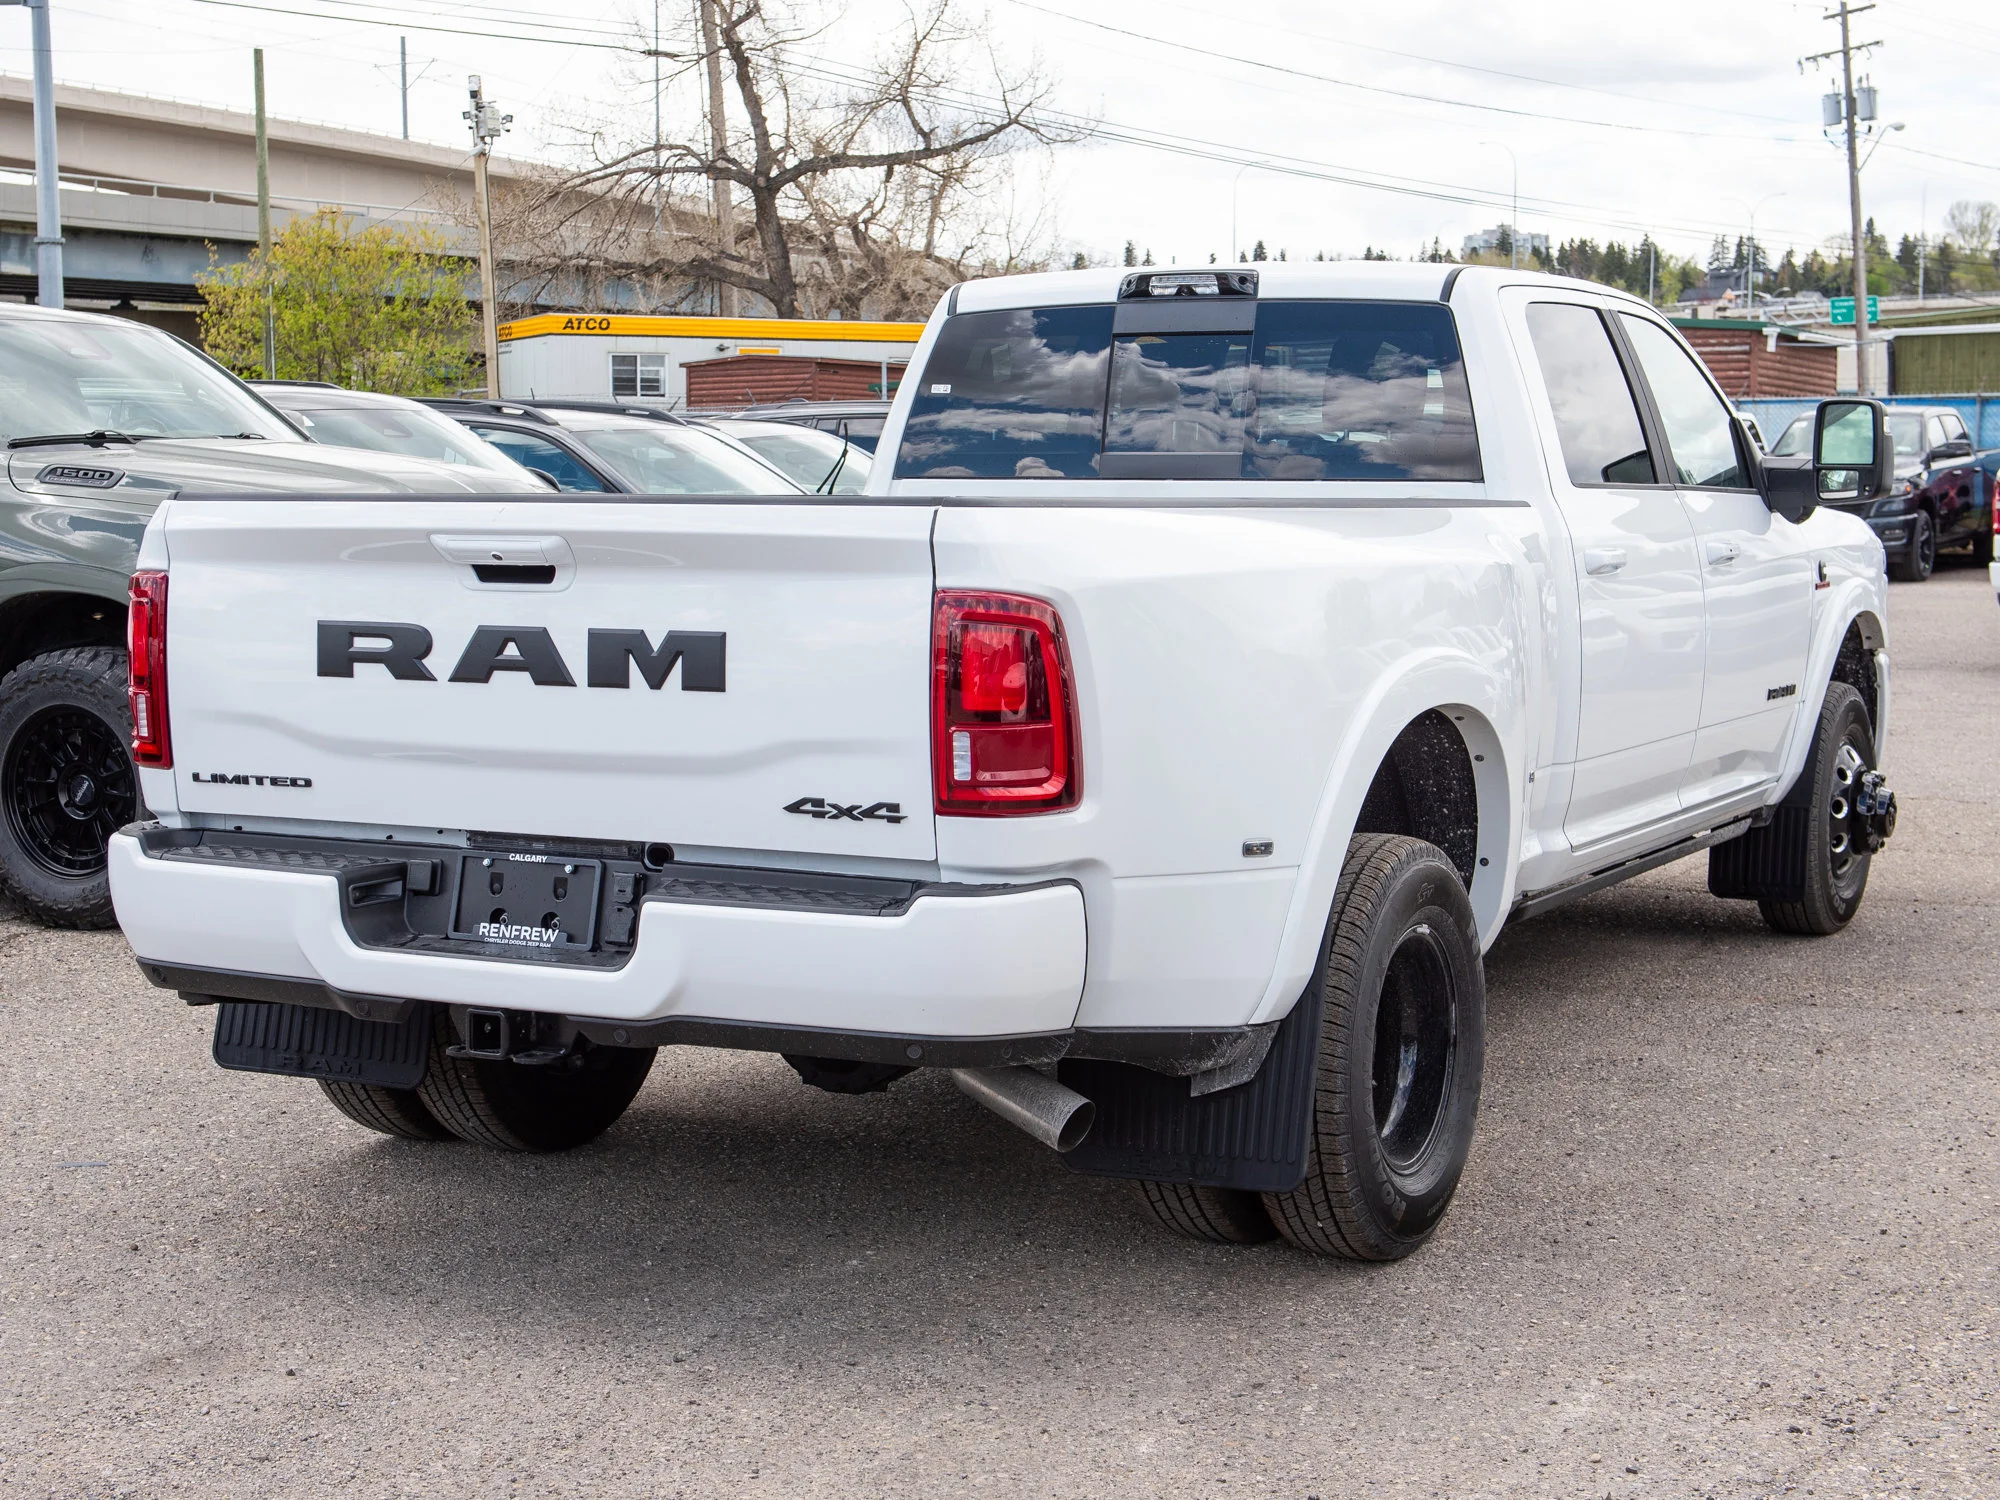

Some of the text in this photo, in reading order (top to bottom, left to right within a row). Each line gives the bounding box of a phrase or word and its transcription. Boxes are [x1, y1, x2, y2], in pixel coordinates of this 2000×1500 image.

[562, 317, 611, 331] ATCO
[56, 468, 110, 481] 1500
[317, 620, 726, 692] RAM
[192, 772, 312, 787] LIMITED
[782, 797, 908, 824] 4x4
[509, 853, 548, 863] CALGARY
[479, 922, 559, 942] RENFREW
